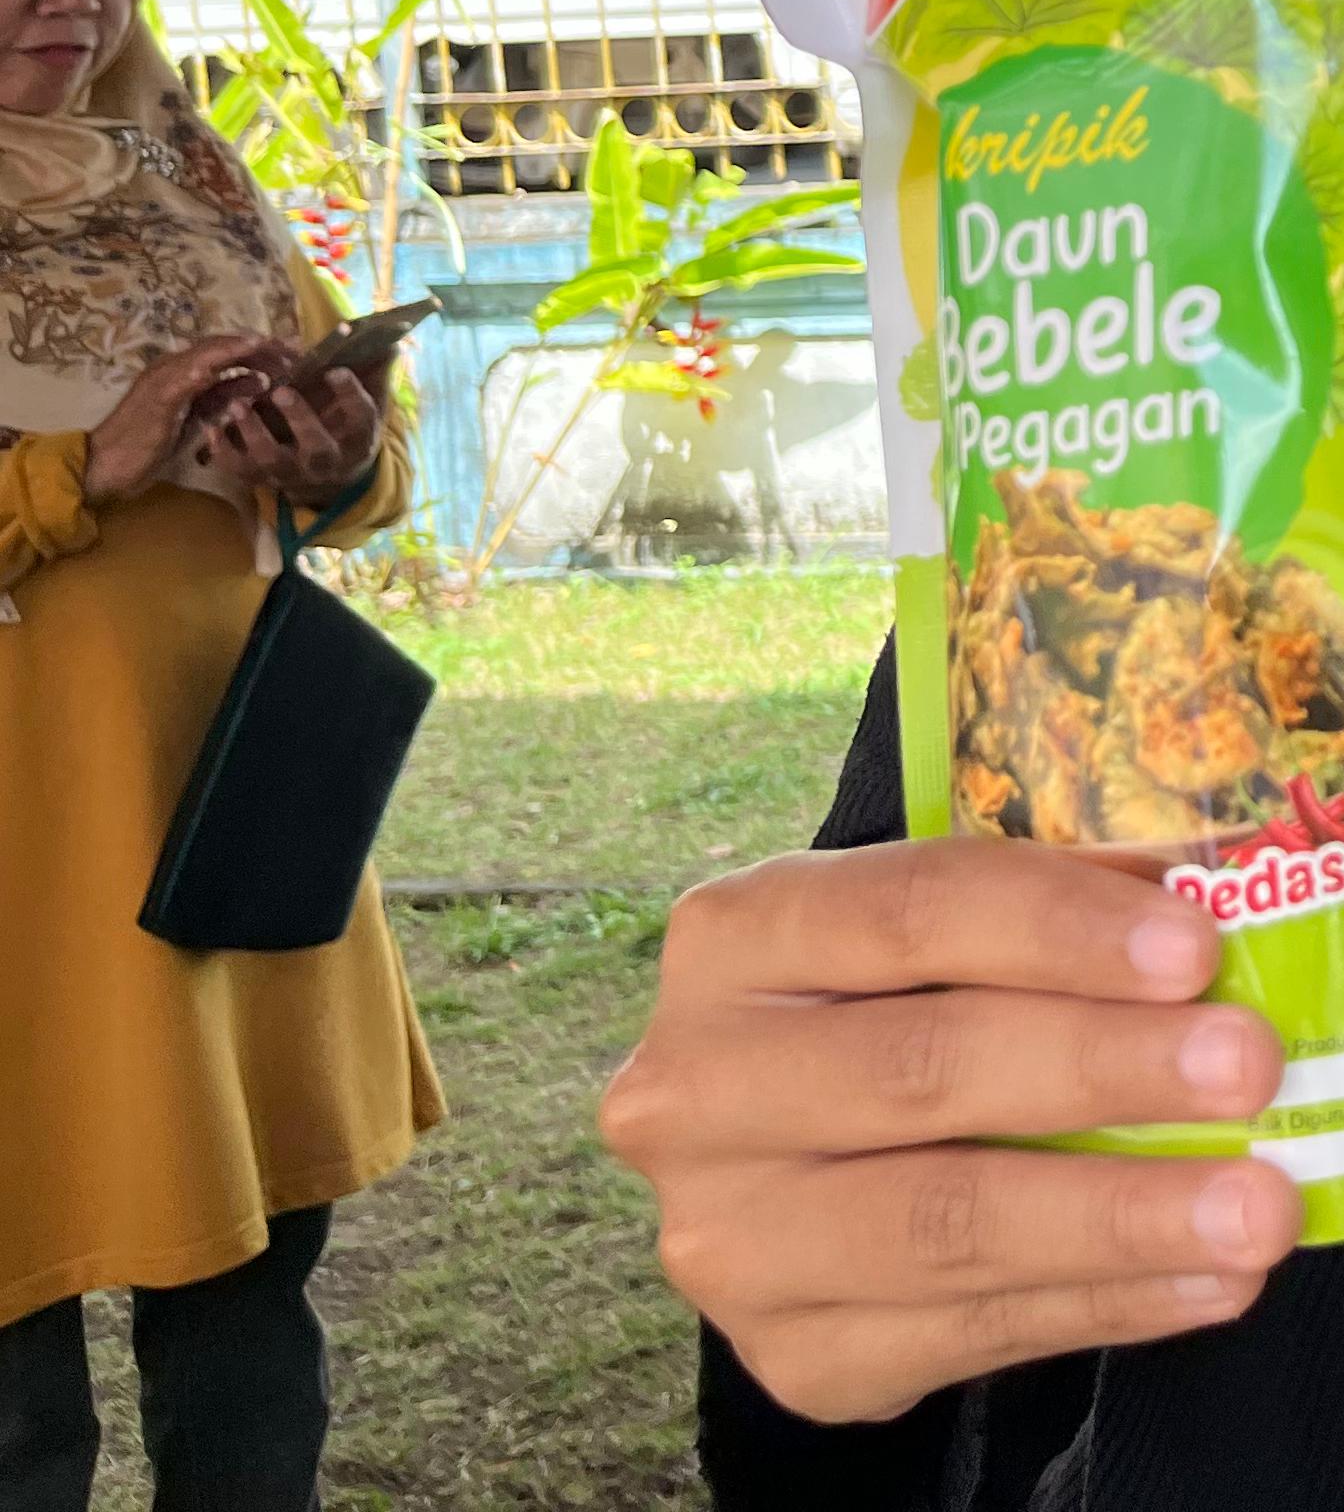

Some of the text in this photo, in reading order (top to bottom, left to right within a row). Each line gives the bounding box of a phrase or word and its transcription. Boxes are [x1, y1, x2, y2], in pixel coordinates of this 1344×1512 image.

[957, 201, 1149, 285] Daun
[942, 261, 1223, 397] Bebele
[956, 388, 1222, 489] Pegagan
